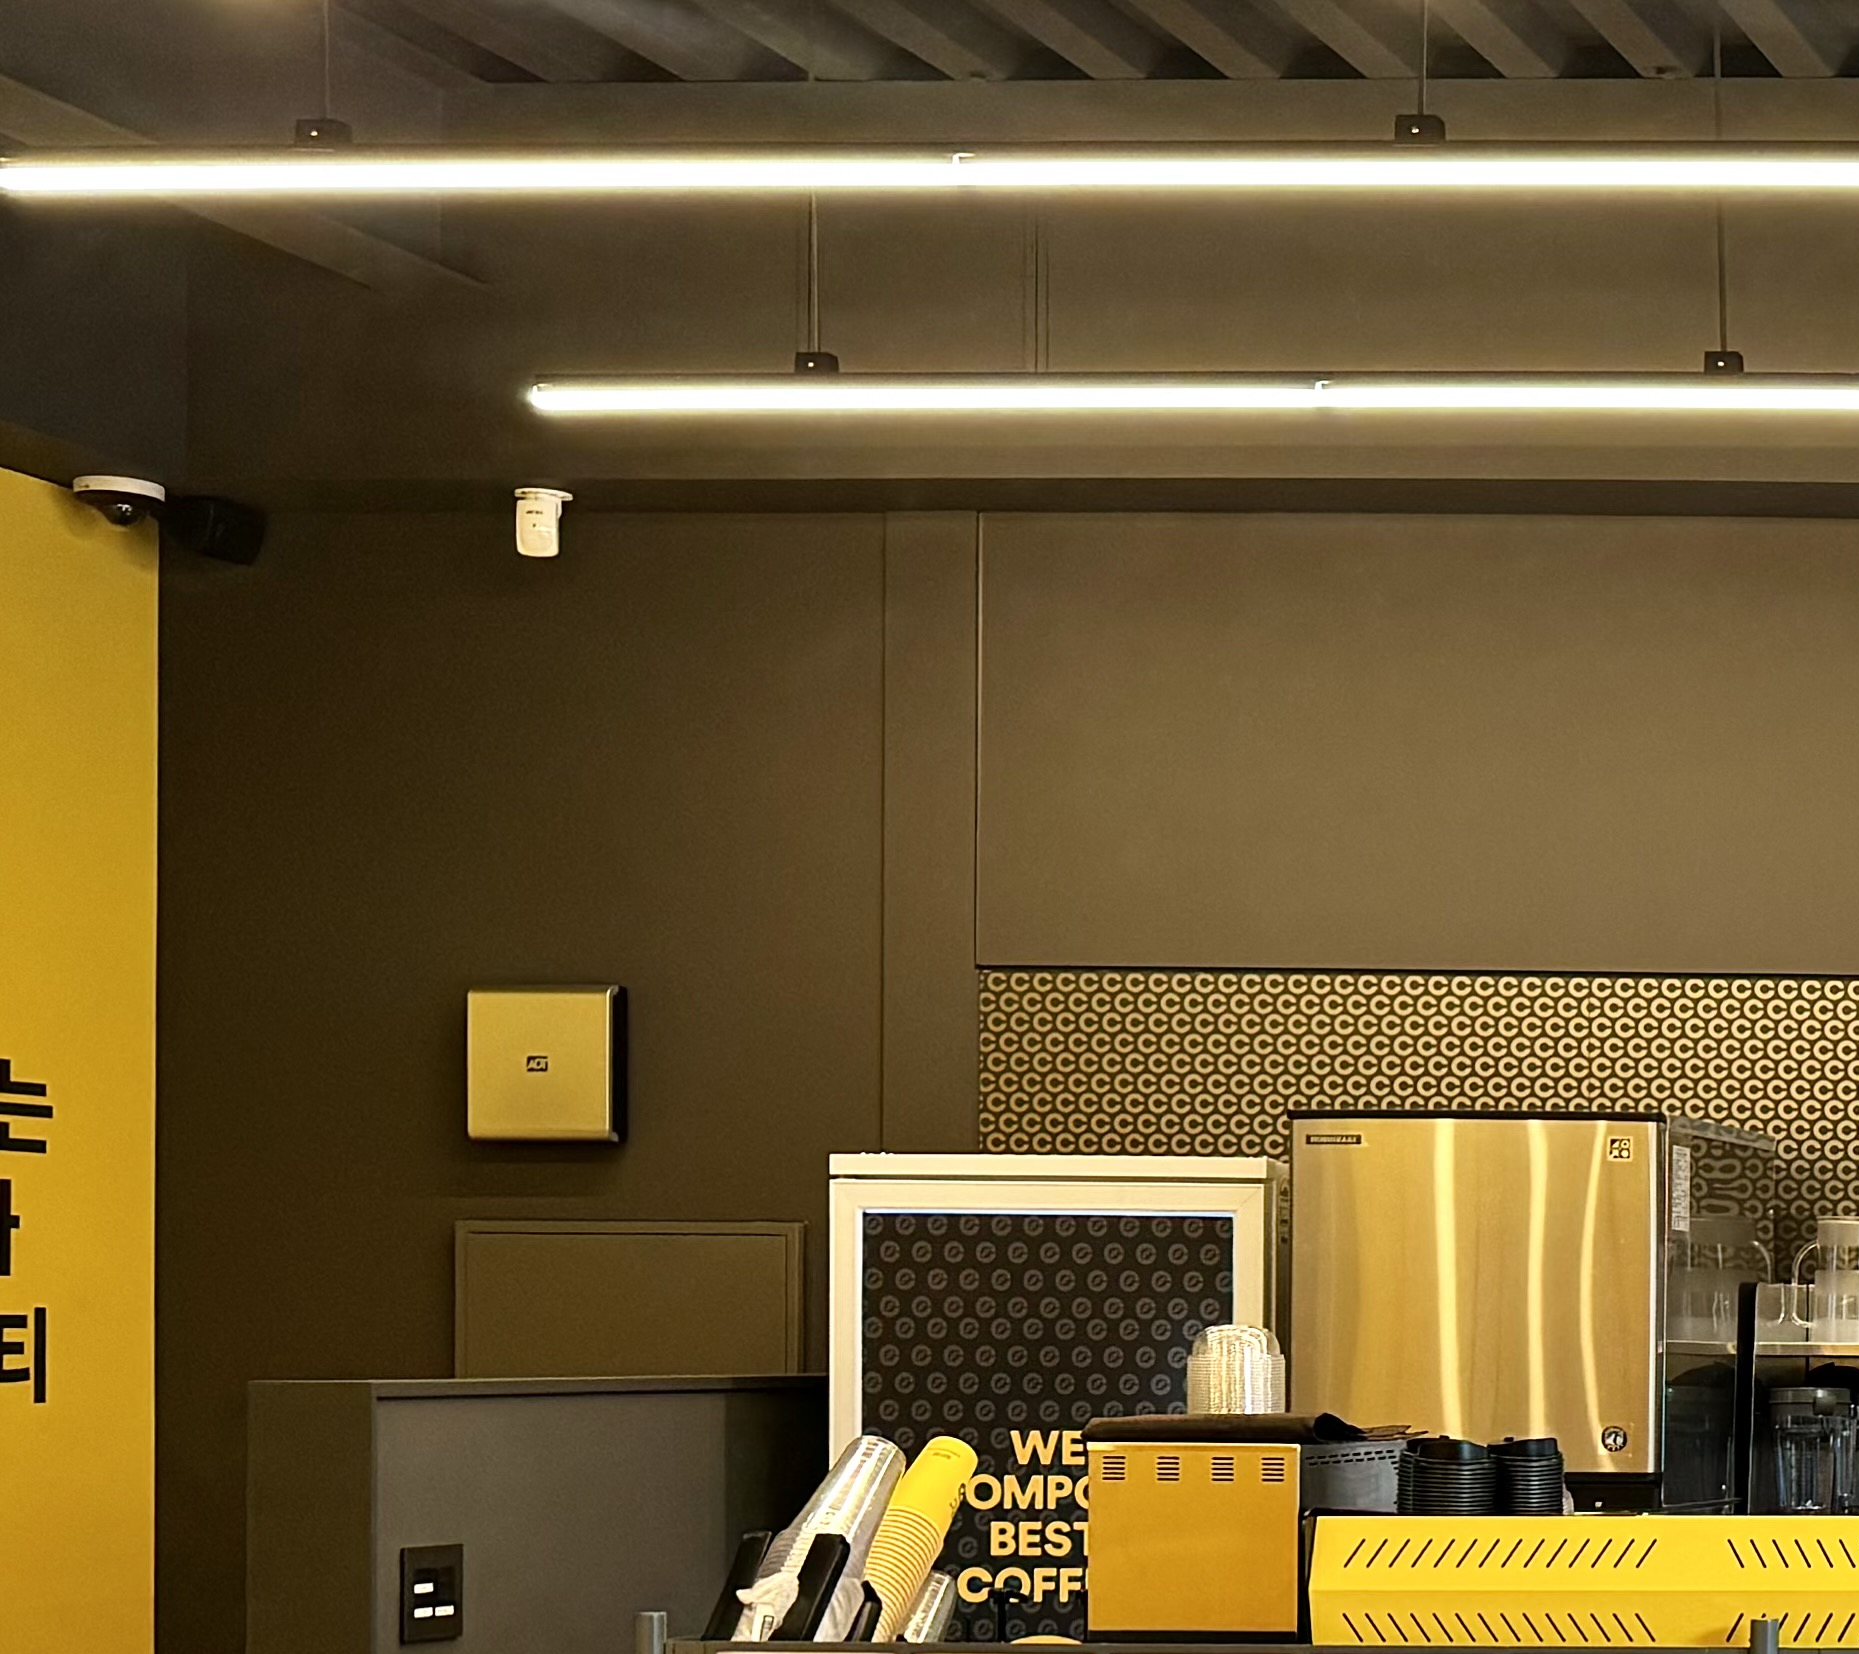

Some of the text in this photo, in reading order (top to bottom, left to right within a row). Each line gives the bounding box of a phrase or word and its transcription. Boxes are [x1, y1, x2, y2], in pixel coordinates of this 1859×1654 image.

[1010, 1430, 1086, 1465] WE
[966, 1474, 1088, 1510] OMP
[957, 1566, 1088, 1603] COFF
